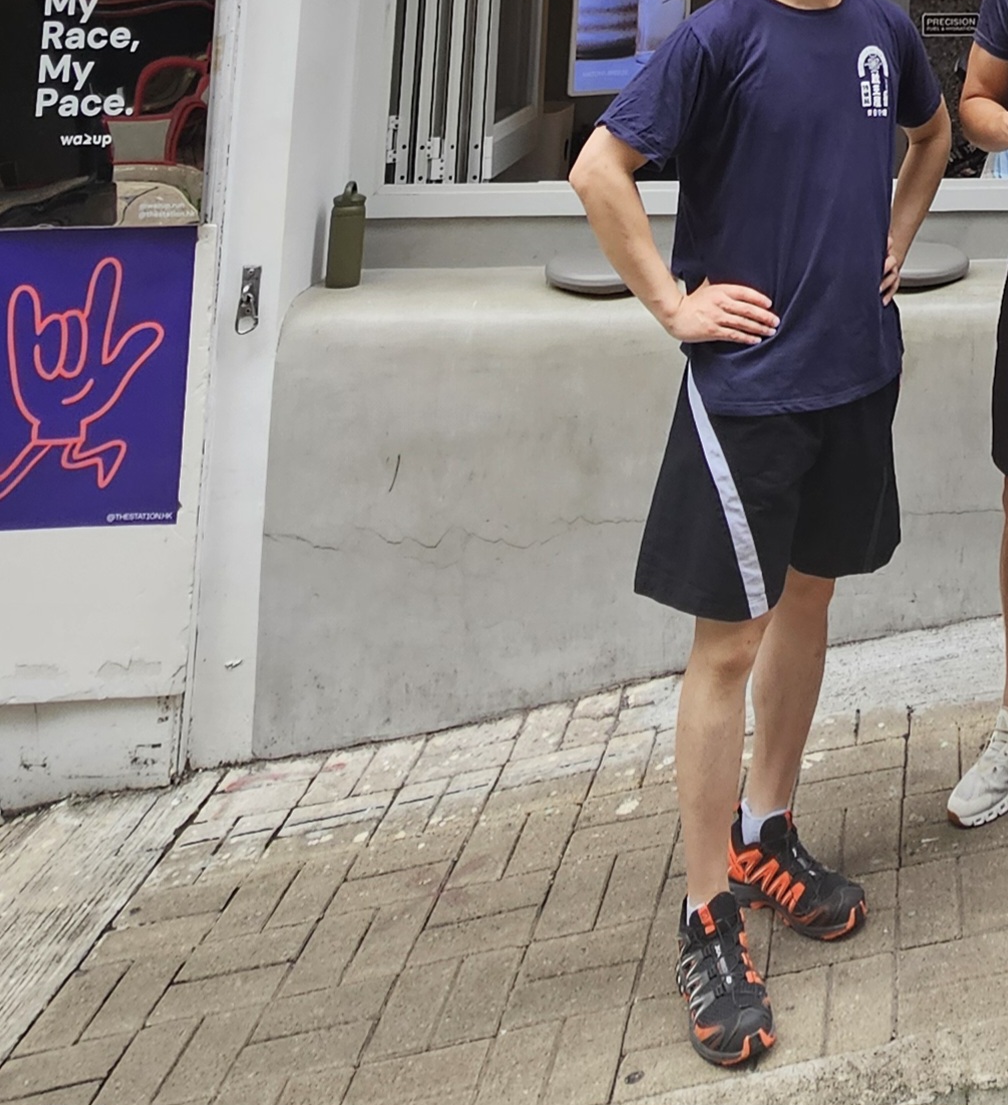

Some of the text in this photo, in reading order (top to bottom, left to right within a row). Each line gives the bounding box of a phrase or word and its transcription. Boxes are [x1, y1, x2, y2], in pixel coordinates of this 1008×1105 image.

[41, 21, 140, 53] Race,
[926, 17, 976, 26] PRECISION
[38, 54, 95, 91] My
[35, 88, 134, 118] Pace.
